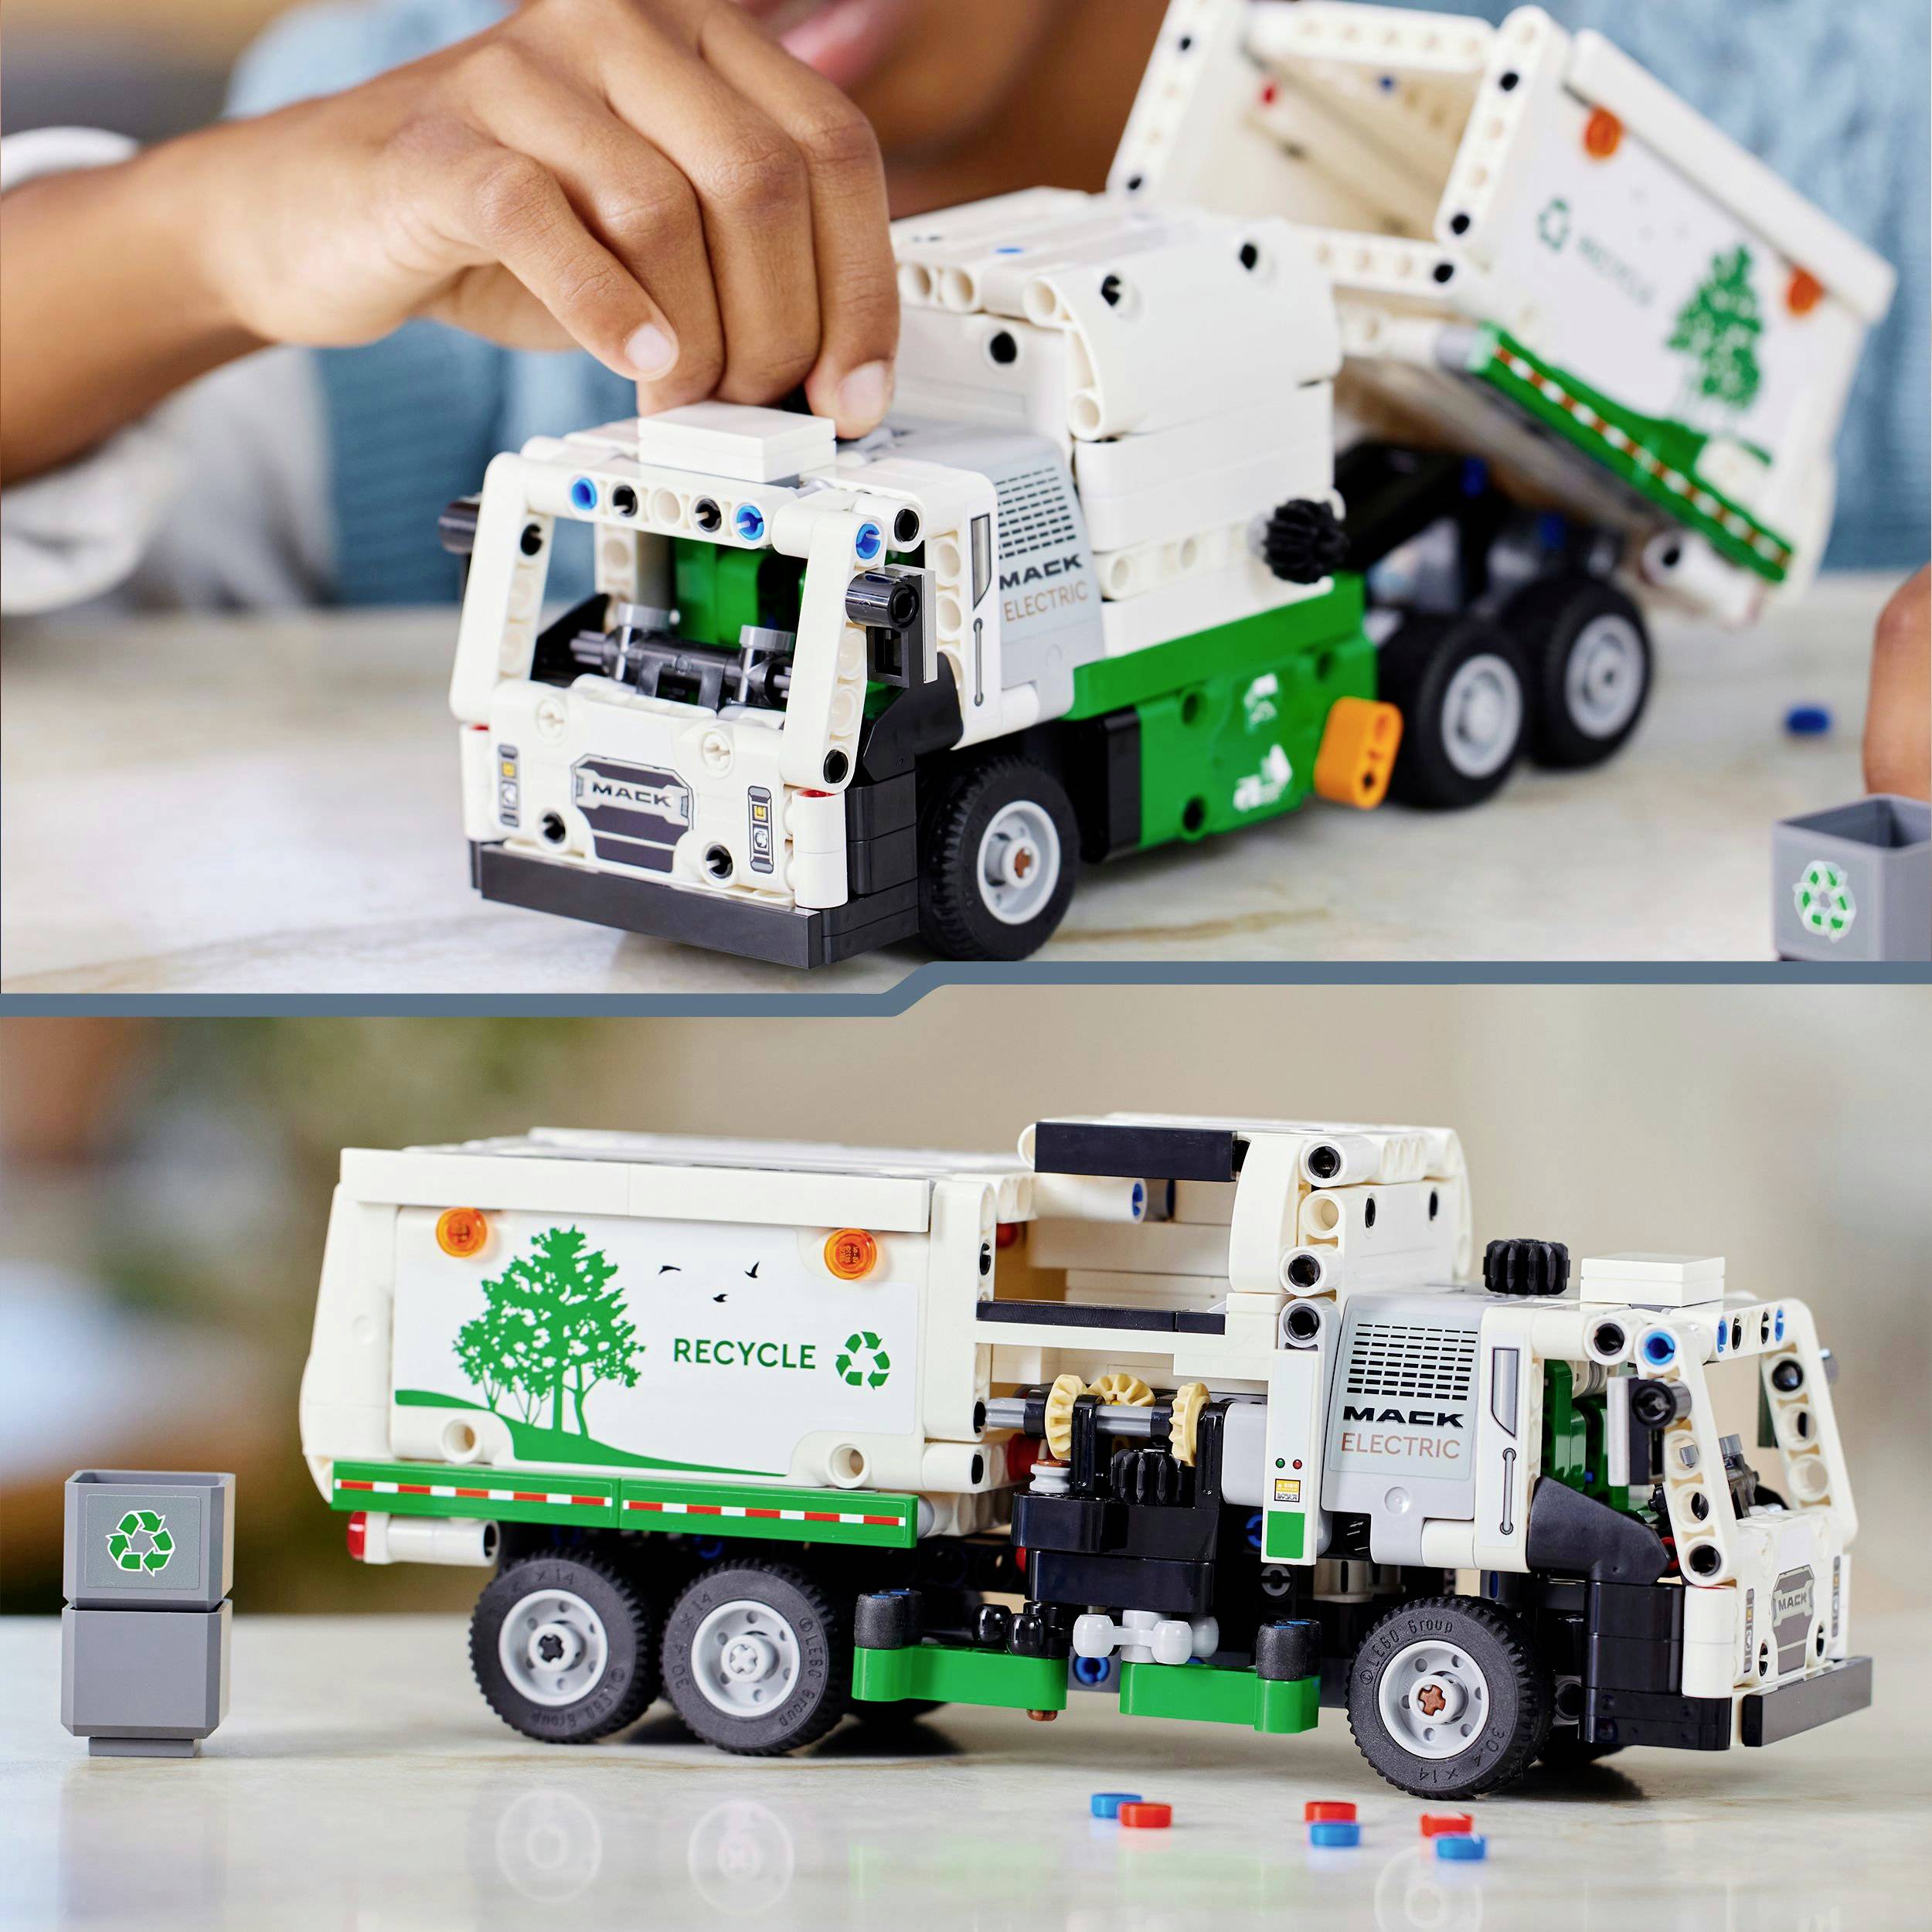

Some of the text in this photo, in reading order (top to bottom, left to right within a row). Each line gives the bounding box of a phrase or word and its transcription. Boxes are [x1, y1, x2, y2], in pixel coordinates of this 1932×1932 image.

[999, 553, 1083, 590] MACK
[1004, 580, 1088, 622] ELECTRIC
[592, 781, 672, 808] MACK
[673, 1338, 816, 1369] RECYCLE
[1342, 1406, 1464, 1428] MACK
[1341, 1432, 1461, 1459] ELECTRIC
[1778, 1592, 1807, 1611] MACK
[1407, 1619, 1454, 1634] Group
